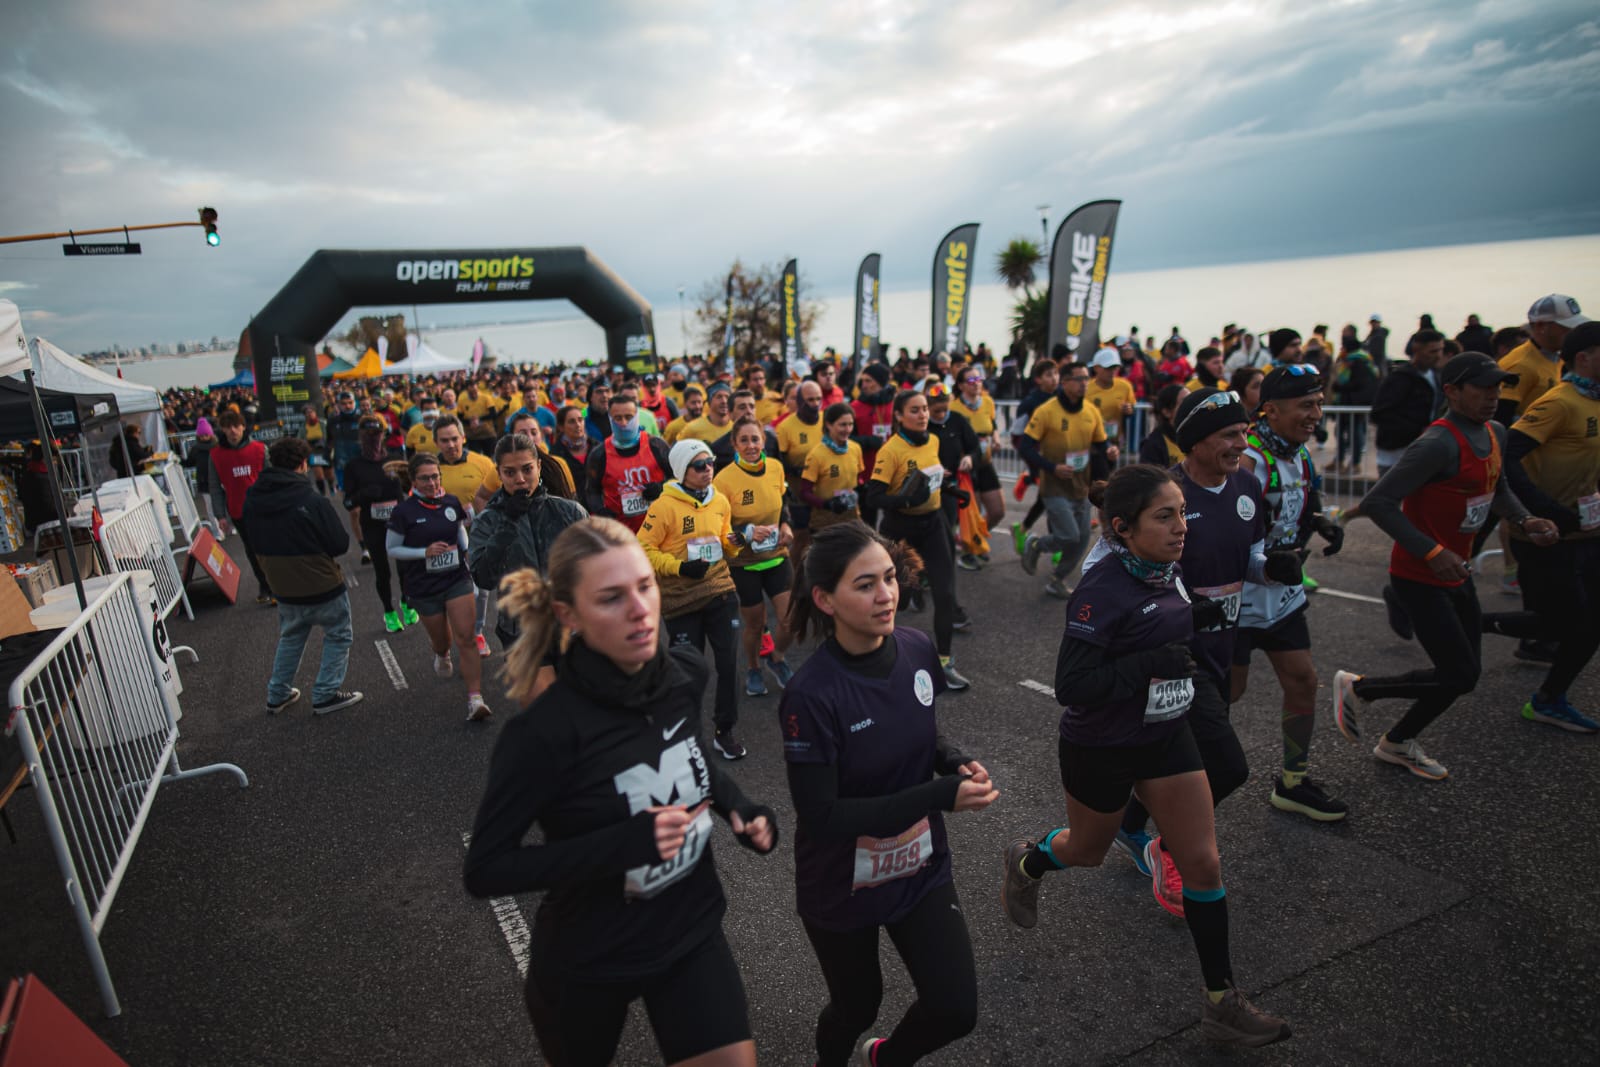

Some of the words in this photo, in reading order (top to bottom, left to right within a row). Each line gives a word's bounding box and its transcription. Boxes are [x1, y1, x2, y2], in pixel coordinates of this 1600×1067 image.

[80, 246, 126, 255] Viamonte
[396, 255, 535, 285] opensports
[232, 465, 252, 478] STAFF
[430, 552, 454, 567] 2027
[870, 842, 920, 879] 1459
